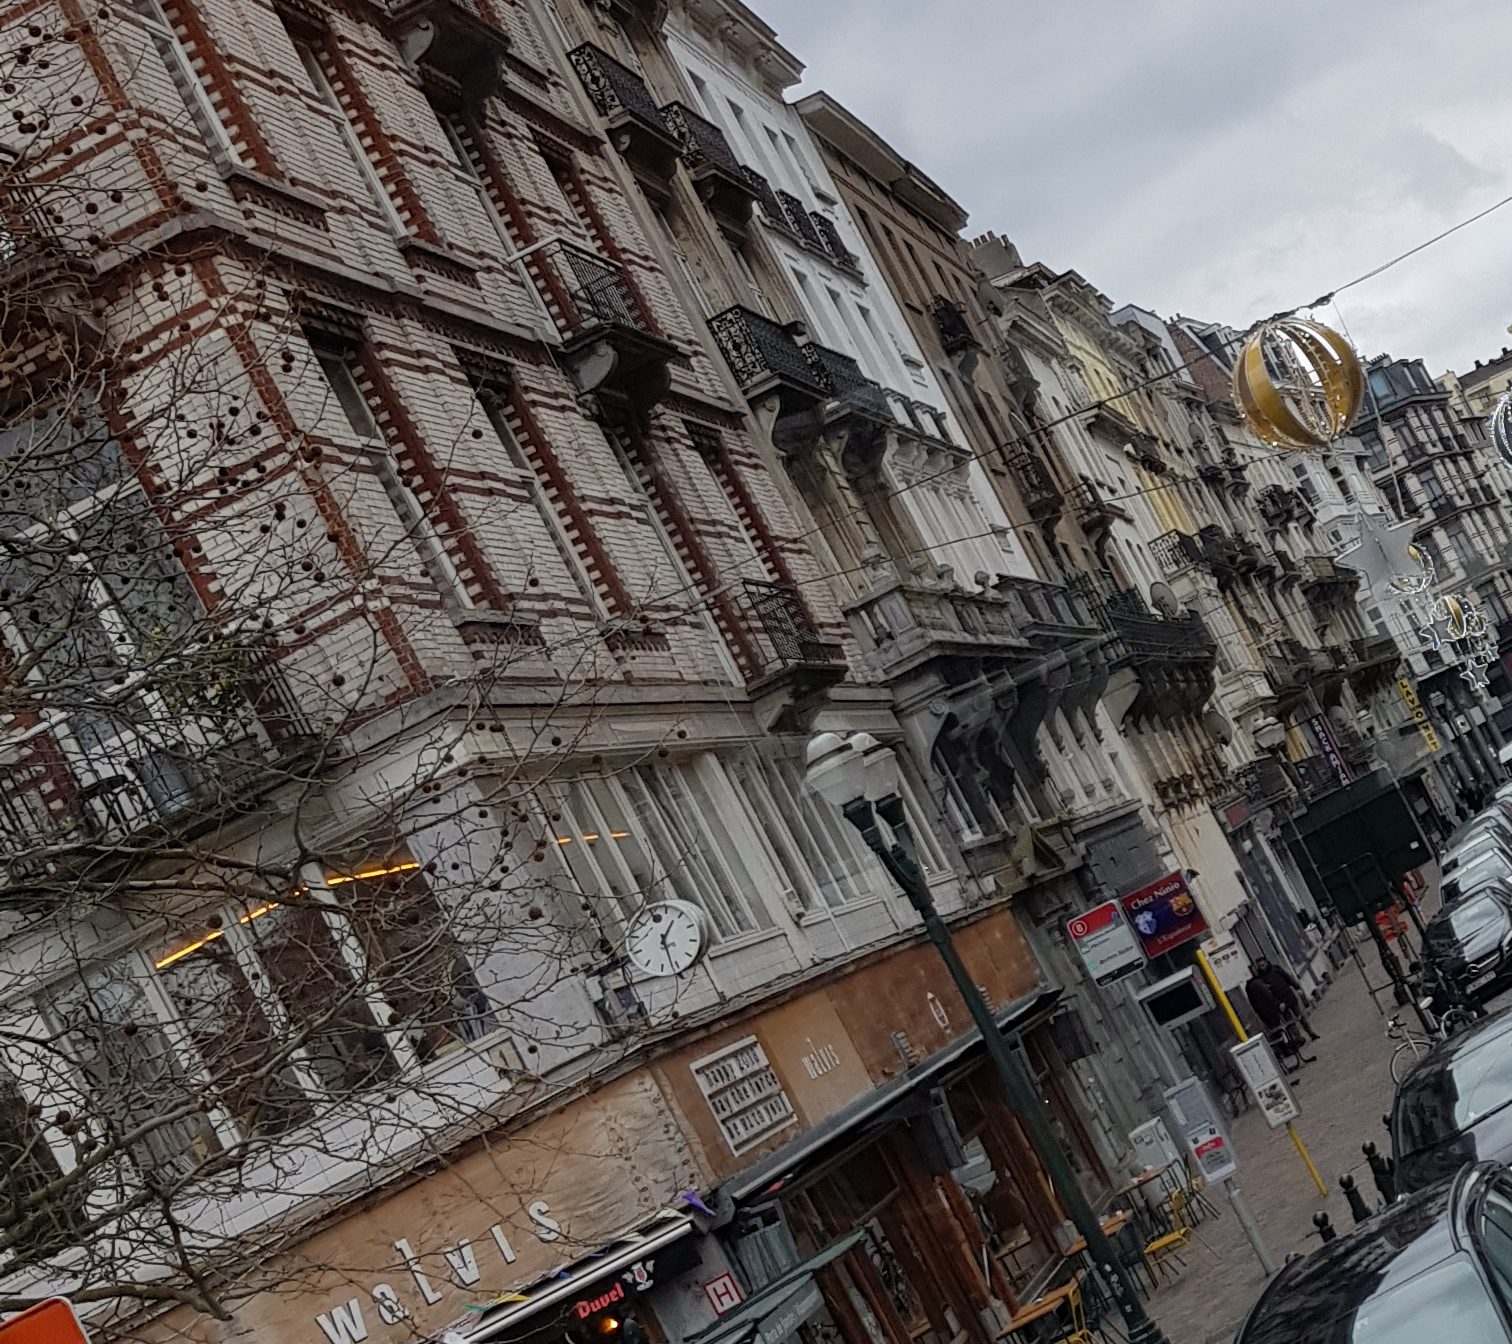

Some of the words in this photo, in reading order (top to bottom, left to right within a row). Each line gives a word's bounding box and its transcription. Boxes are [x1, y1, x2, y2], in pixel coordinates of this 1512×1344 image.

[1129, 892, 1154, 910] Chez
[801, 1037, 841, 1080] walvis
[702, 1061, 736, 1087] happy
[576, 1282, 624, 1318] Duvel
[713, 1282, 734, 1307] H
